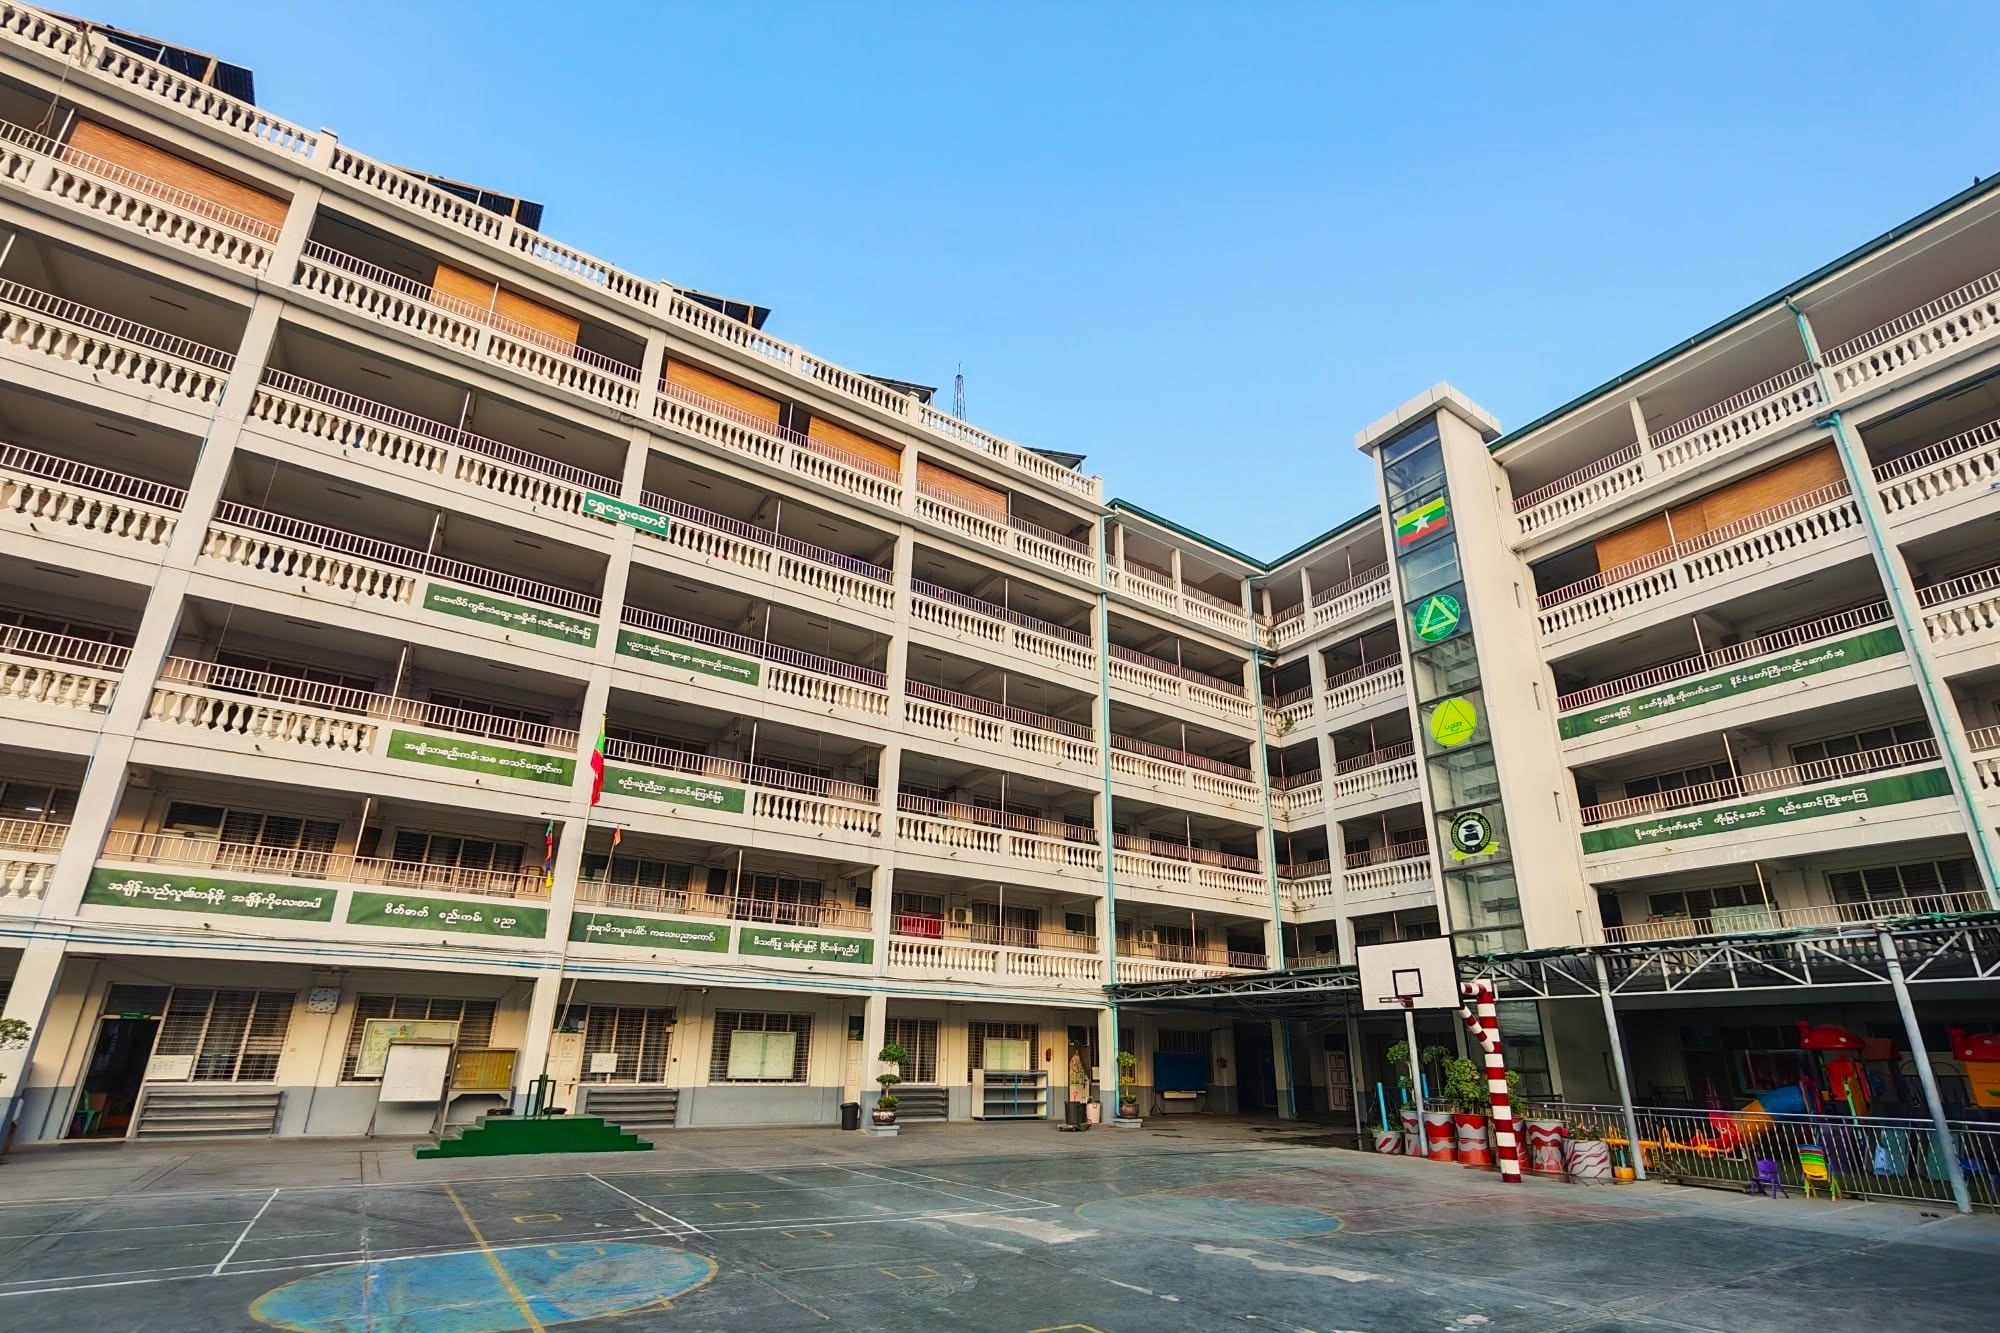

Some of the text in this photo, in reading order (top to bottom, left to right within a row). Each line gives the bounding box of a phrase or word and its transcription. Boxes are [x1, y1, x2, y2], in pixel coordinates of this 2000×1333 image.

[438, 909, 483, 925] စည်းကမ်း
[493, 918, 517, 929] ပညာ
